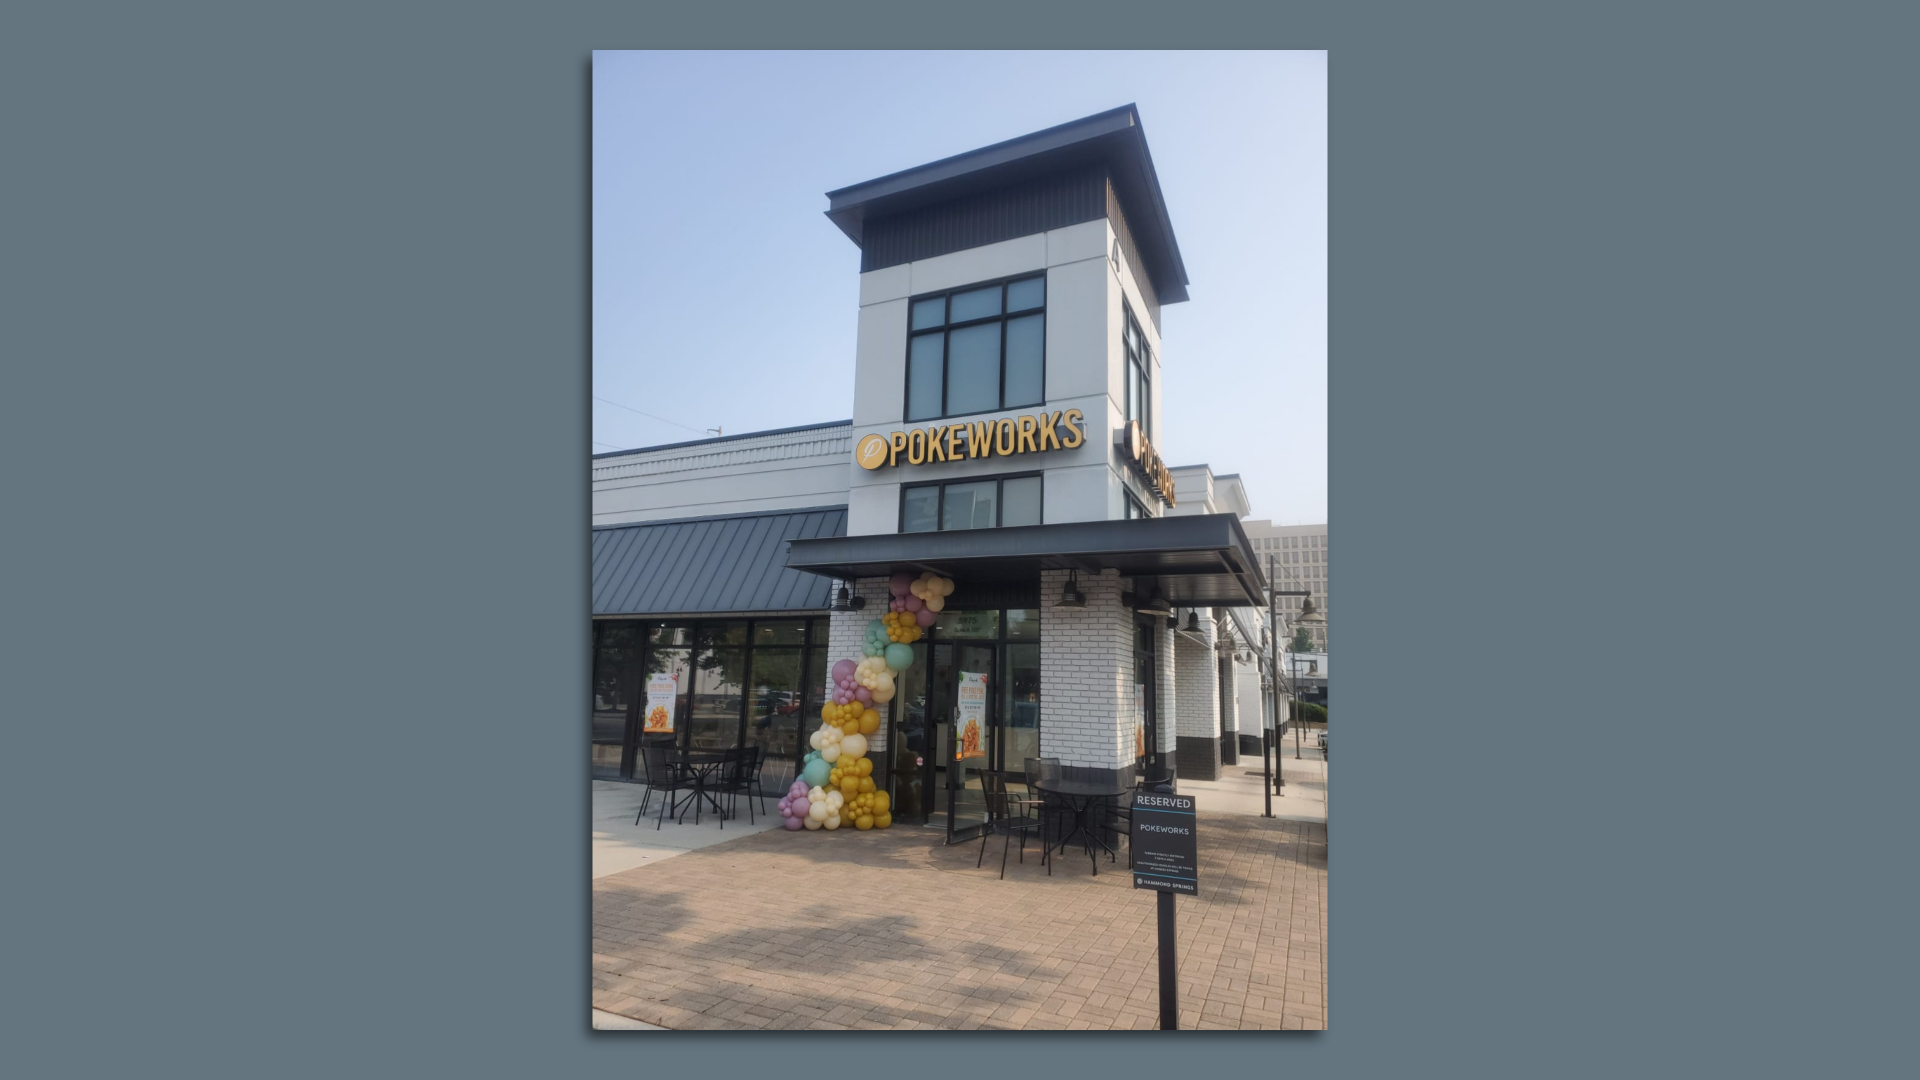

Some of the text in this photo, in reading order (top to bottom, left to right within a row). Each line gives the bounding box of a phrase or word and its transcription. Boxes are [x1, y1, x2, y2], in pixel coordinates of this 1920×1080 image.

[1112, 238, 1120, 273] A
[890, 408, 1086, 467] POKEWORKS
[1137, 795, 1191, 809] RESERVED
[1140, 824, 1190, 836] POKEWORKS
[1143, 879, 1194, 891] HAMMOND SPRINGS
